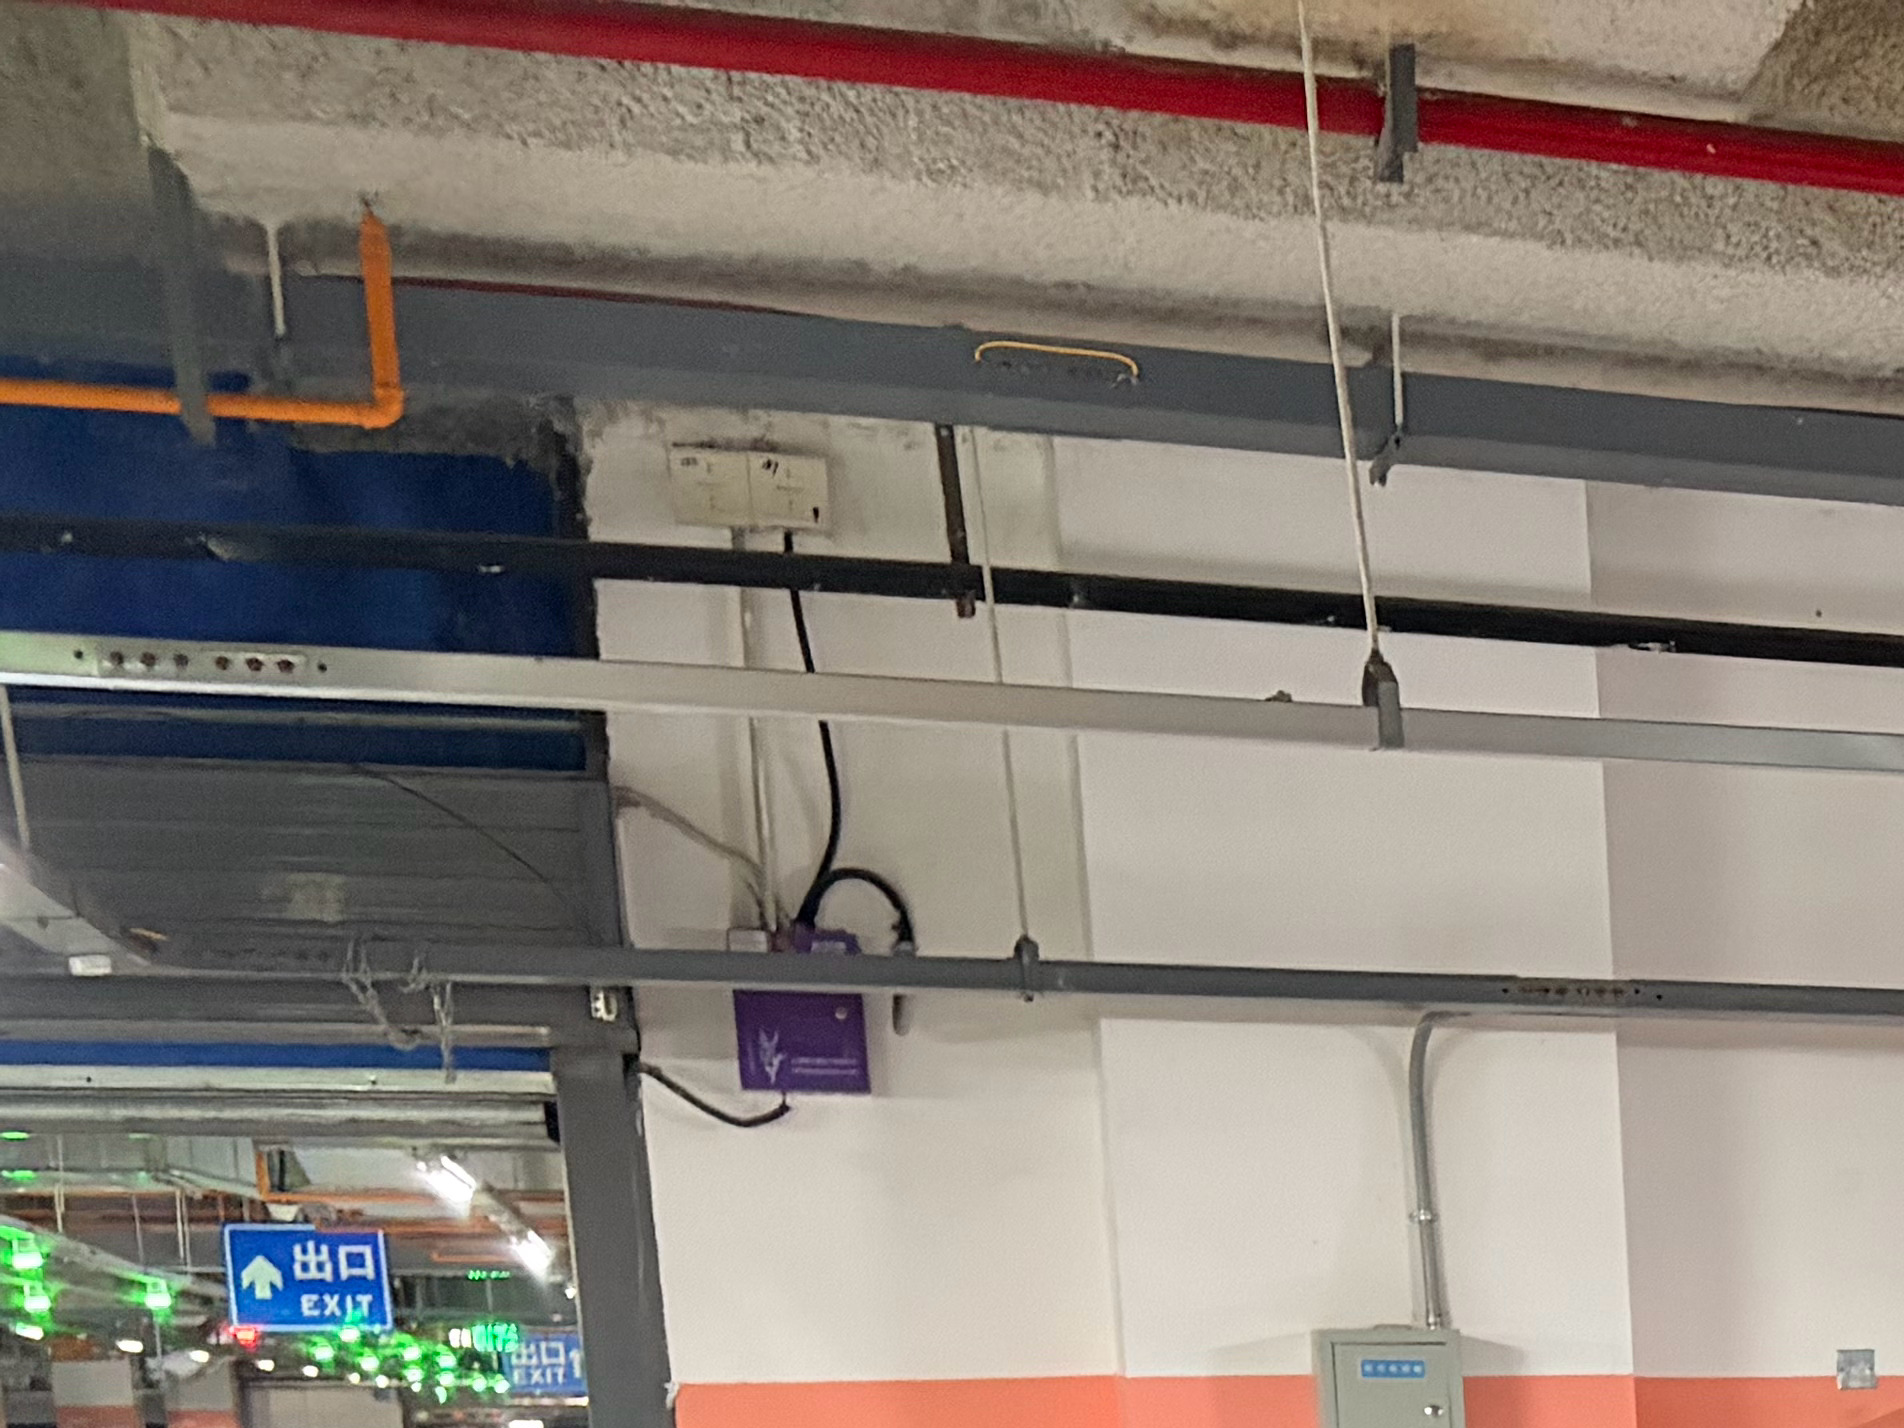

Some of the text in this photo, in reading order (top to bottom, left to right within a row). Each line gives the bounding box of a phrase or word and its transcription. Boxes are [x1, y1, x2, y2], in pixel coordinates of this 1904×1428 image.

[292, 1240, 376, 1283] 出口
[300, 1293, 374, 1317] EXIT
[511, 1341, 566, 1365] 出口
[513, 1368, 566, 1385] EXIT
